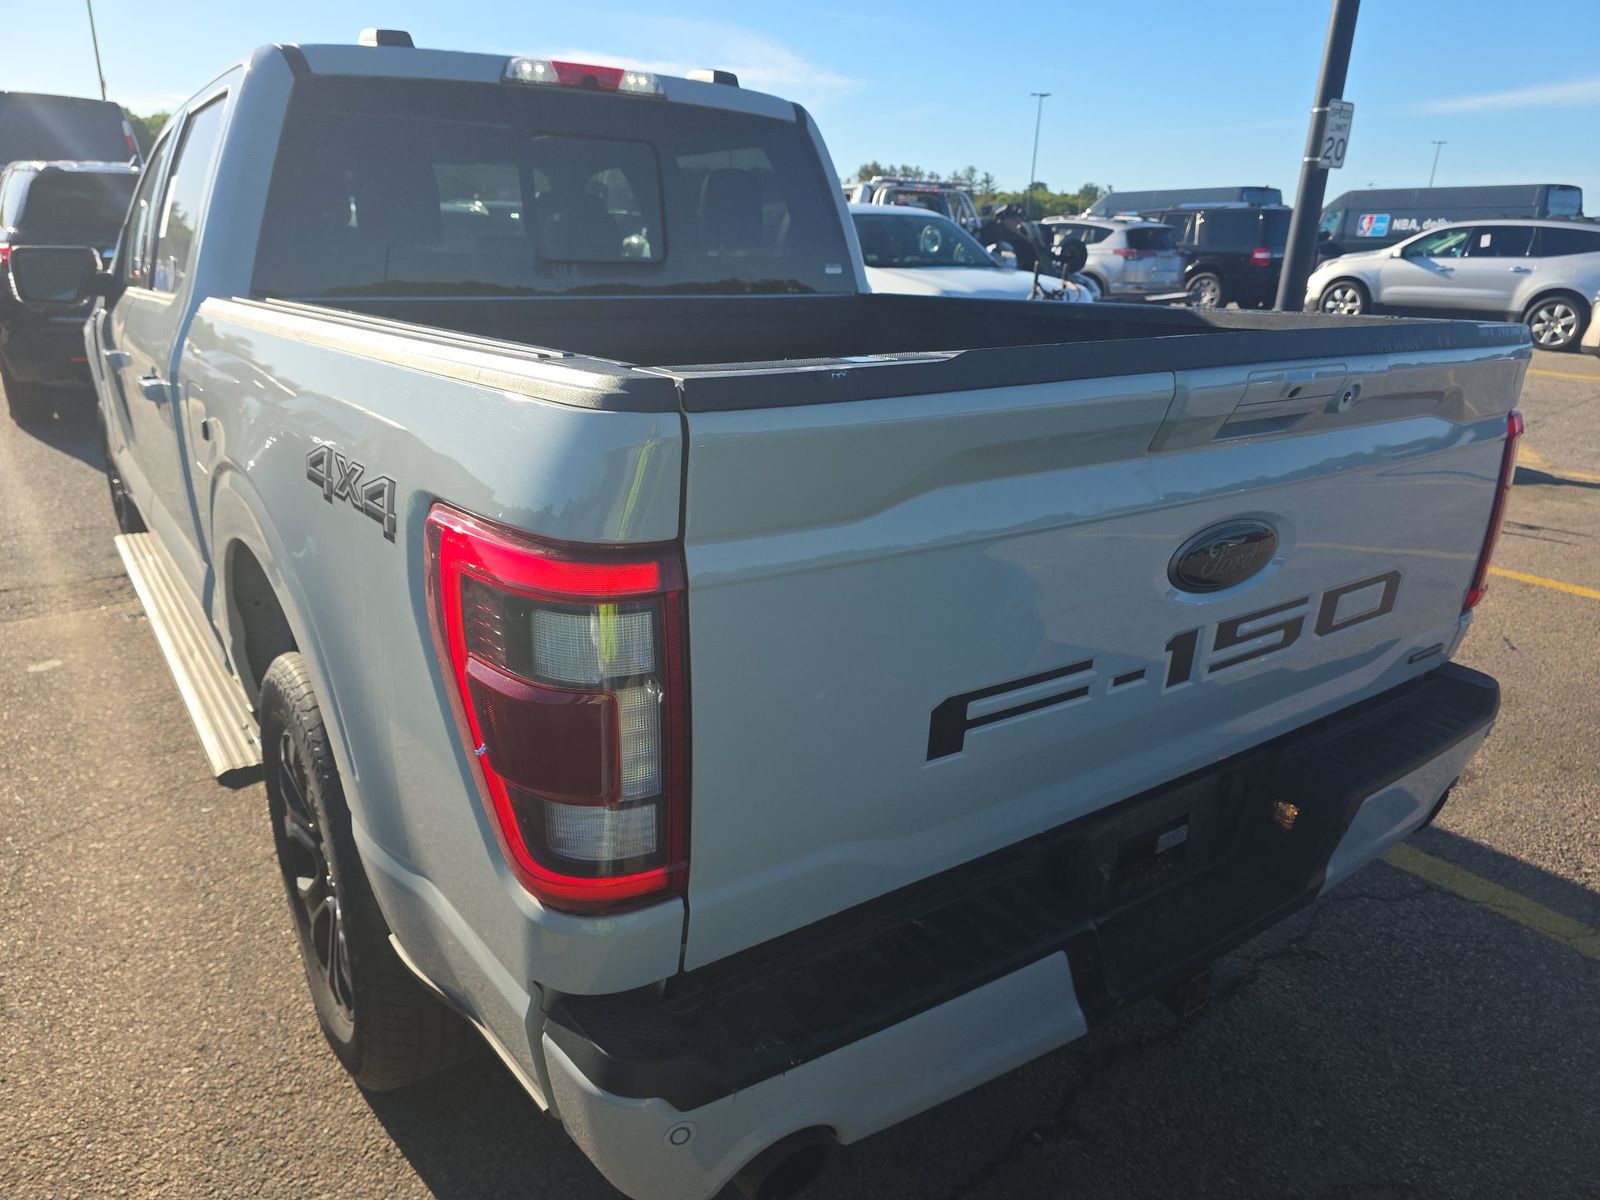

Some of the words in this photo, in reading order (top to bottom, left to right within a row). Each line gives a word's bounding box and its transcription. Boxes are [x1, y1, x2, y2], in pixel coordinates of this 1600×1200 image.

[1323, 137, 1346, 161] 20
[1391, 218, 1420, 232] NBA,
[1201, 535, 1260, 578] Ford
[926, 570, 1400, 762] F-150
